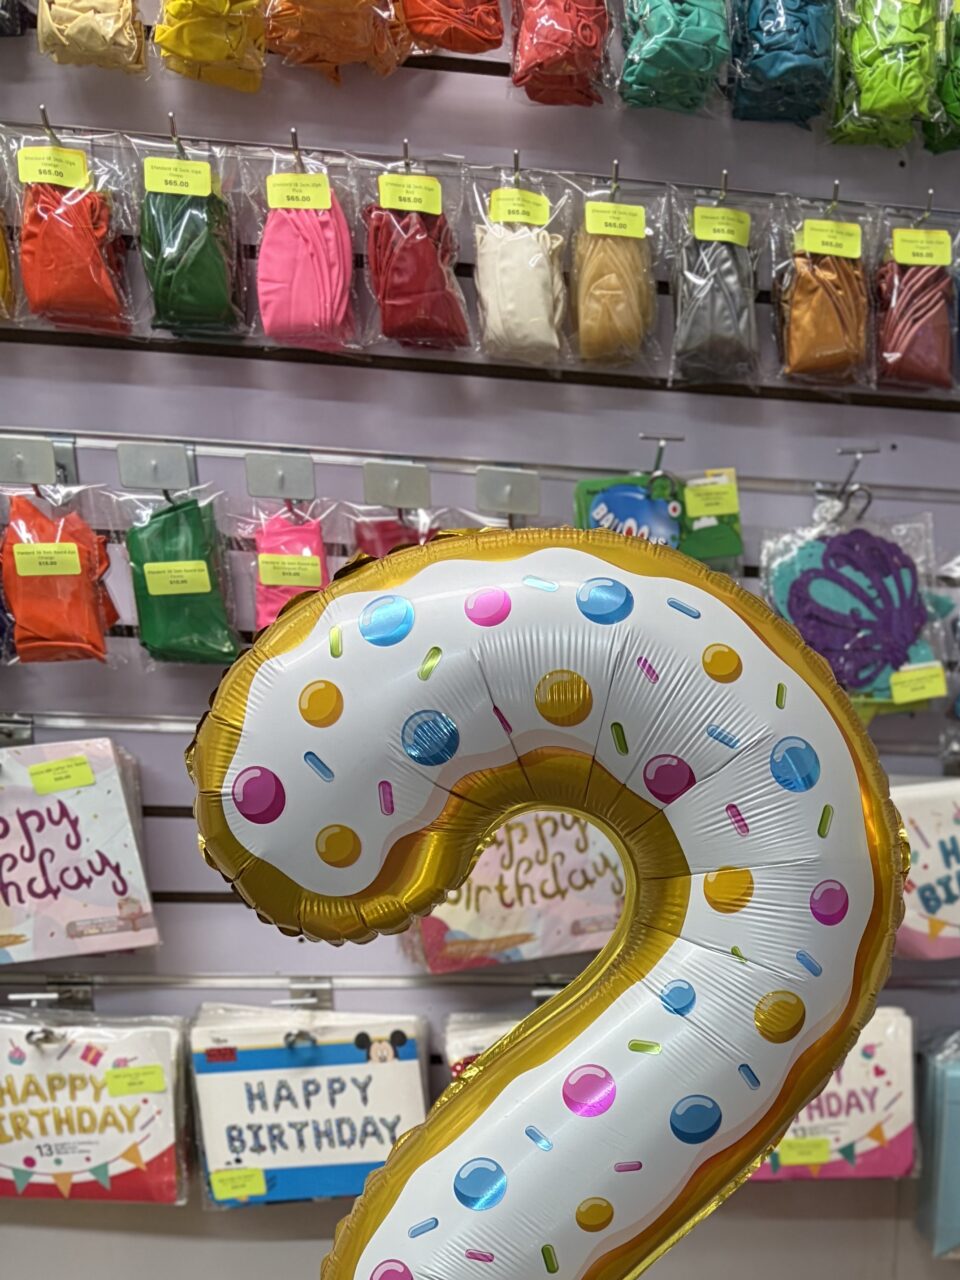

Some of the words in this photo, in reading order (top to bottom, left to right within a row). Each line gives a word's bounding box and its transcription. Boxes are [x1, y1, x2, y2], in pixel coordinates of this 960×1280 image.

[38, 168, 64, 178] $65.00
[163, 179, 189, 188] $65.00
[286, 194, 311, 202] $65.00
[397, 195, 423, 204] $65.00
[507, 208, 531, 218] $65.00
[603, 221, 628, 230] $65.00
[490, 813, 589, 870] ppy
[0, 1072, 107, 1108] HAPPY
[244, 1074, 373, 1115] HAPPY
[0, 1103, 141, 1145] IRTHDAY
[225, 1114, 401, 1156] BIRTHDAY
[35, 1142, 54, 1158] 13
